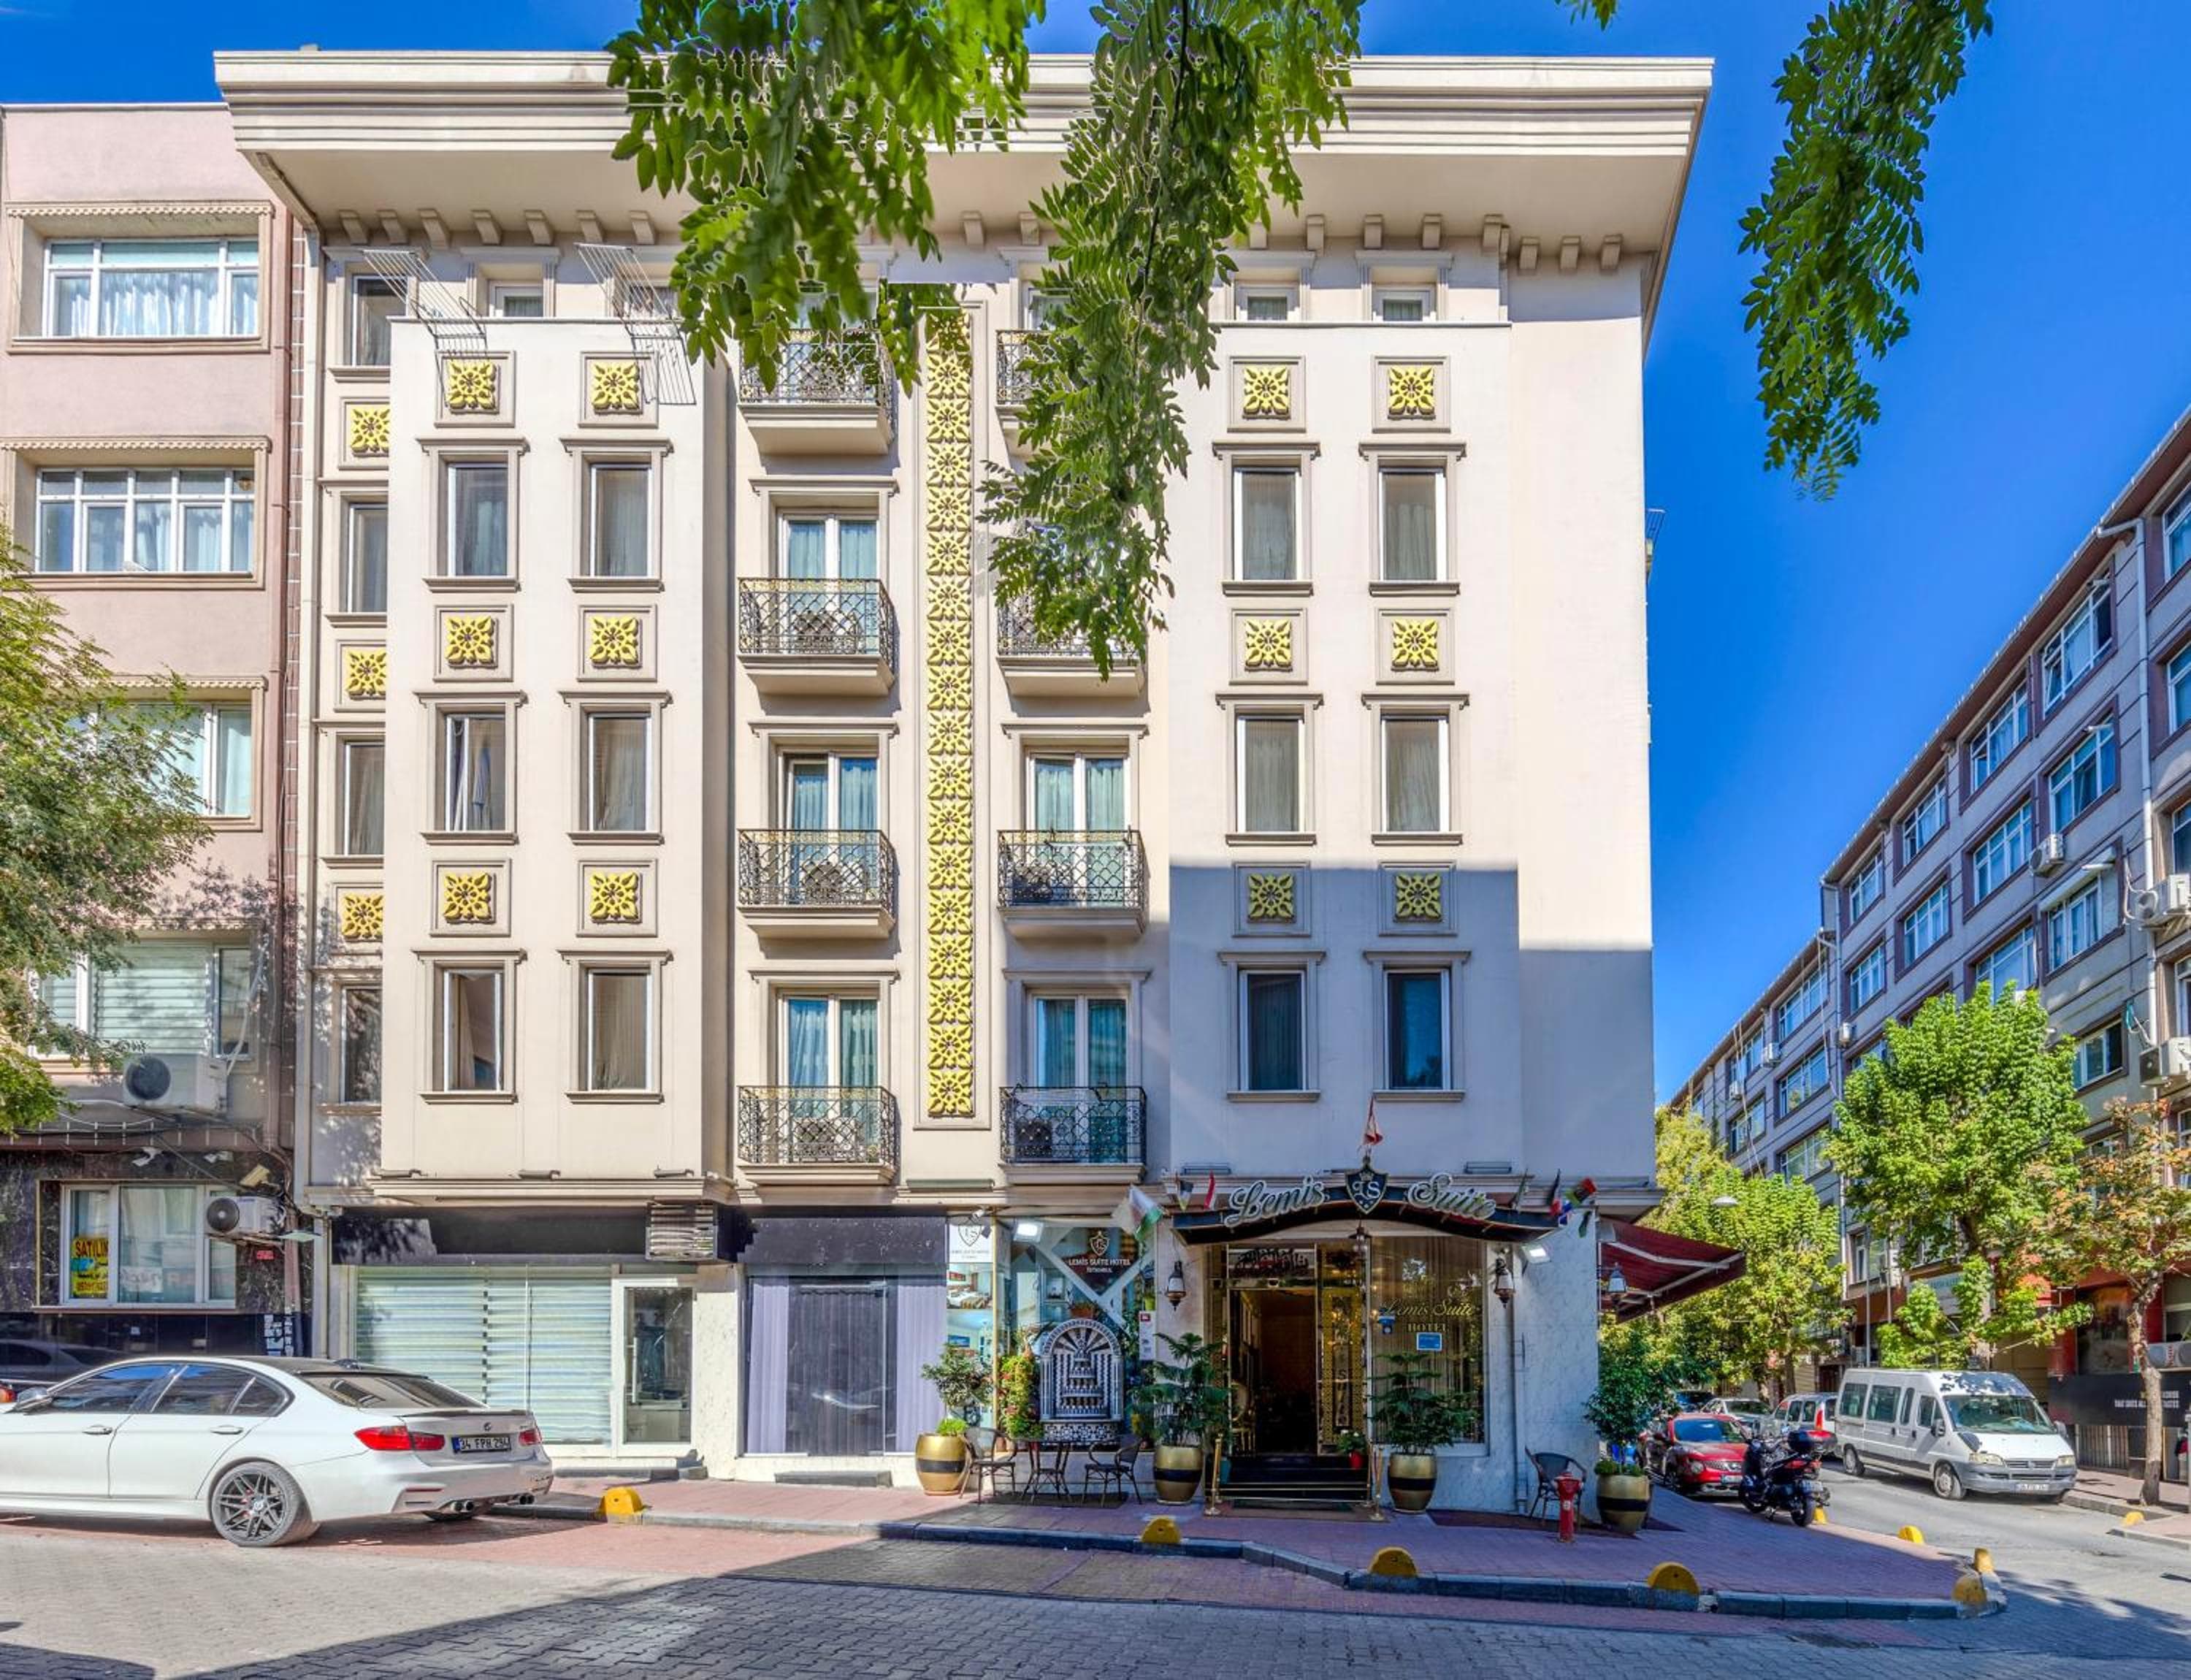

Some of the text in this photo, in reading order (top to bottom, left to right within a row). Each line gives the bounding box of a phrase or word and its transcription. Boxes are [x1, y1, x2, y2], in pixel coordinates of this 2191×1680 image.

[1224, 1172, 1496, 1228] Lemis Suite
[1433, 1298, 1474, 1316] Suite
[1407, 1323, 1448, 1332] HOTEL
[460, 1438, 471, 1449] 34
